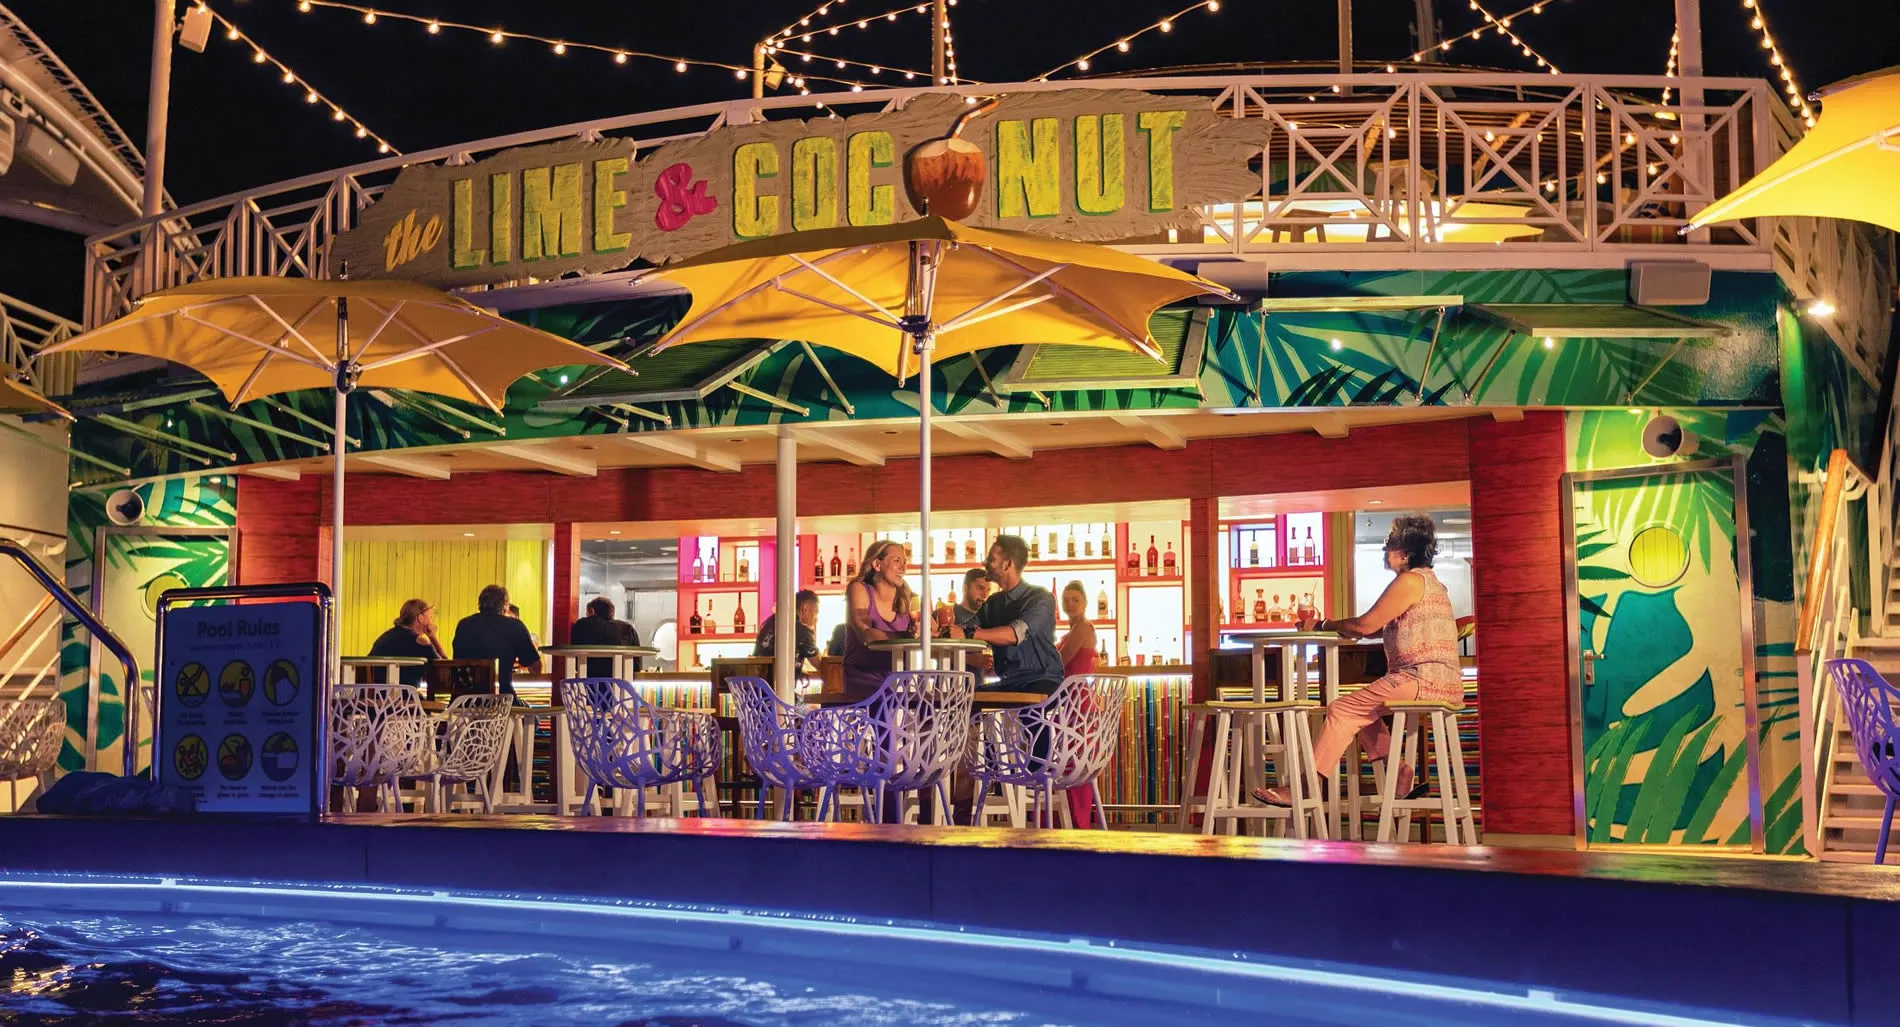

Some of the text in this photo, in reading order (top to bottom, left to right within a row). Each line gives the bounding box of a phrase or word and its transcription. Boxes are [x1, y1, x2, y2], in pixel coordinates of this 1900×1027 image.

[383, 208, 444, 271] the
[453, 158, 632, 269] LIME
[655, 162, 718, 232] &
[198, 618, 280, 638] Pool Rules
